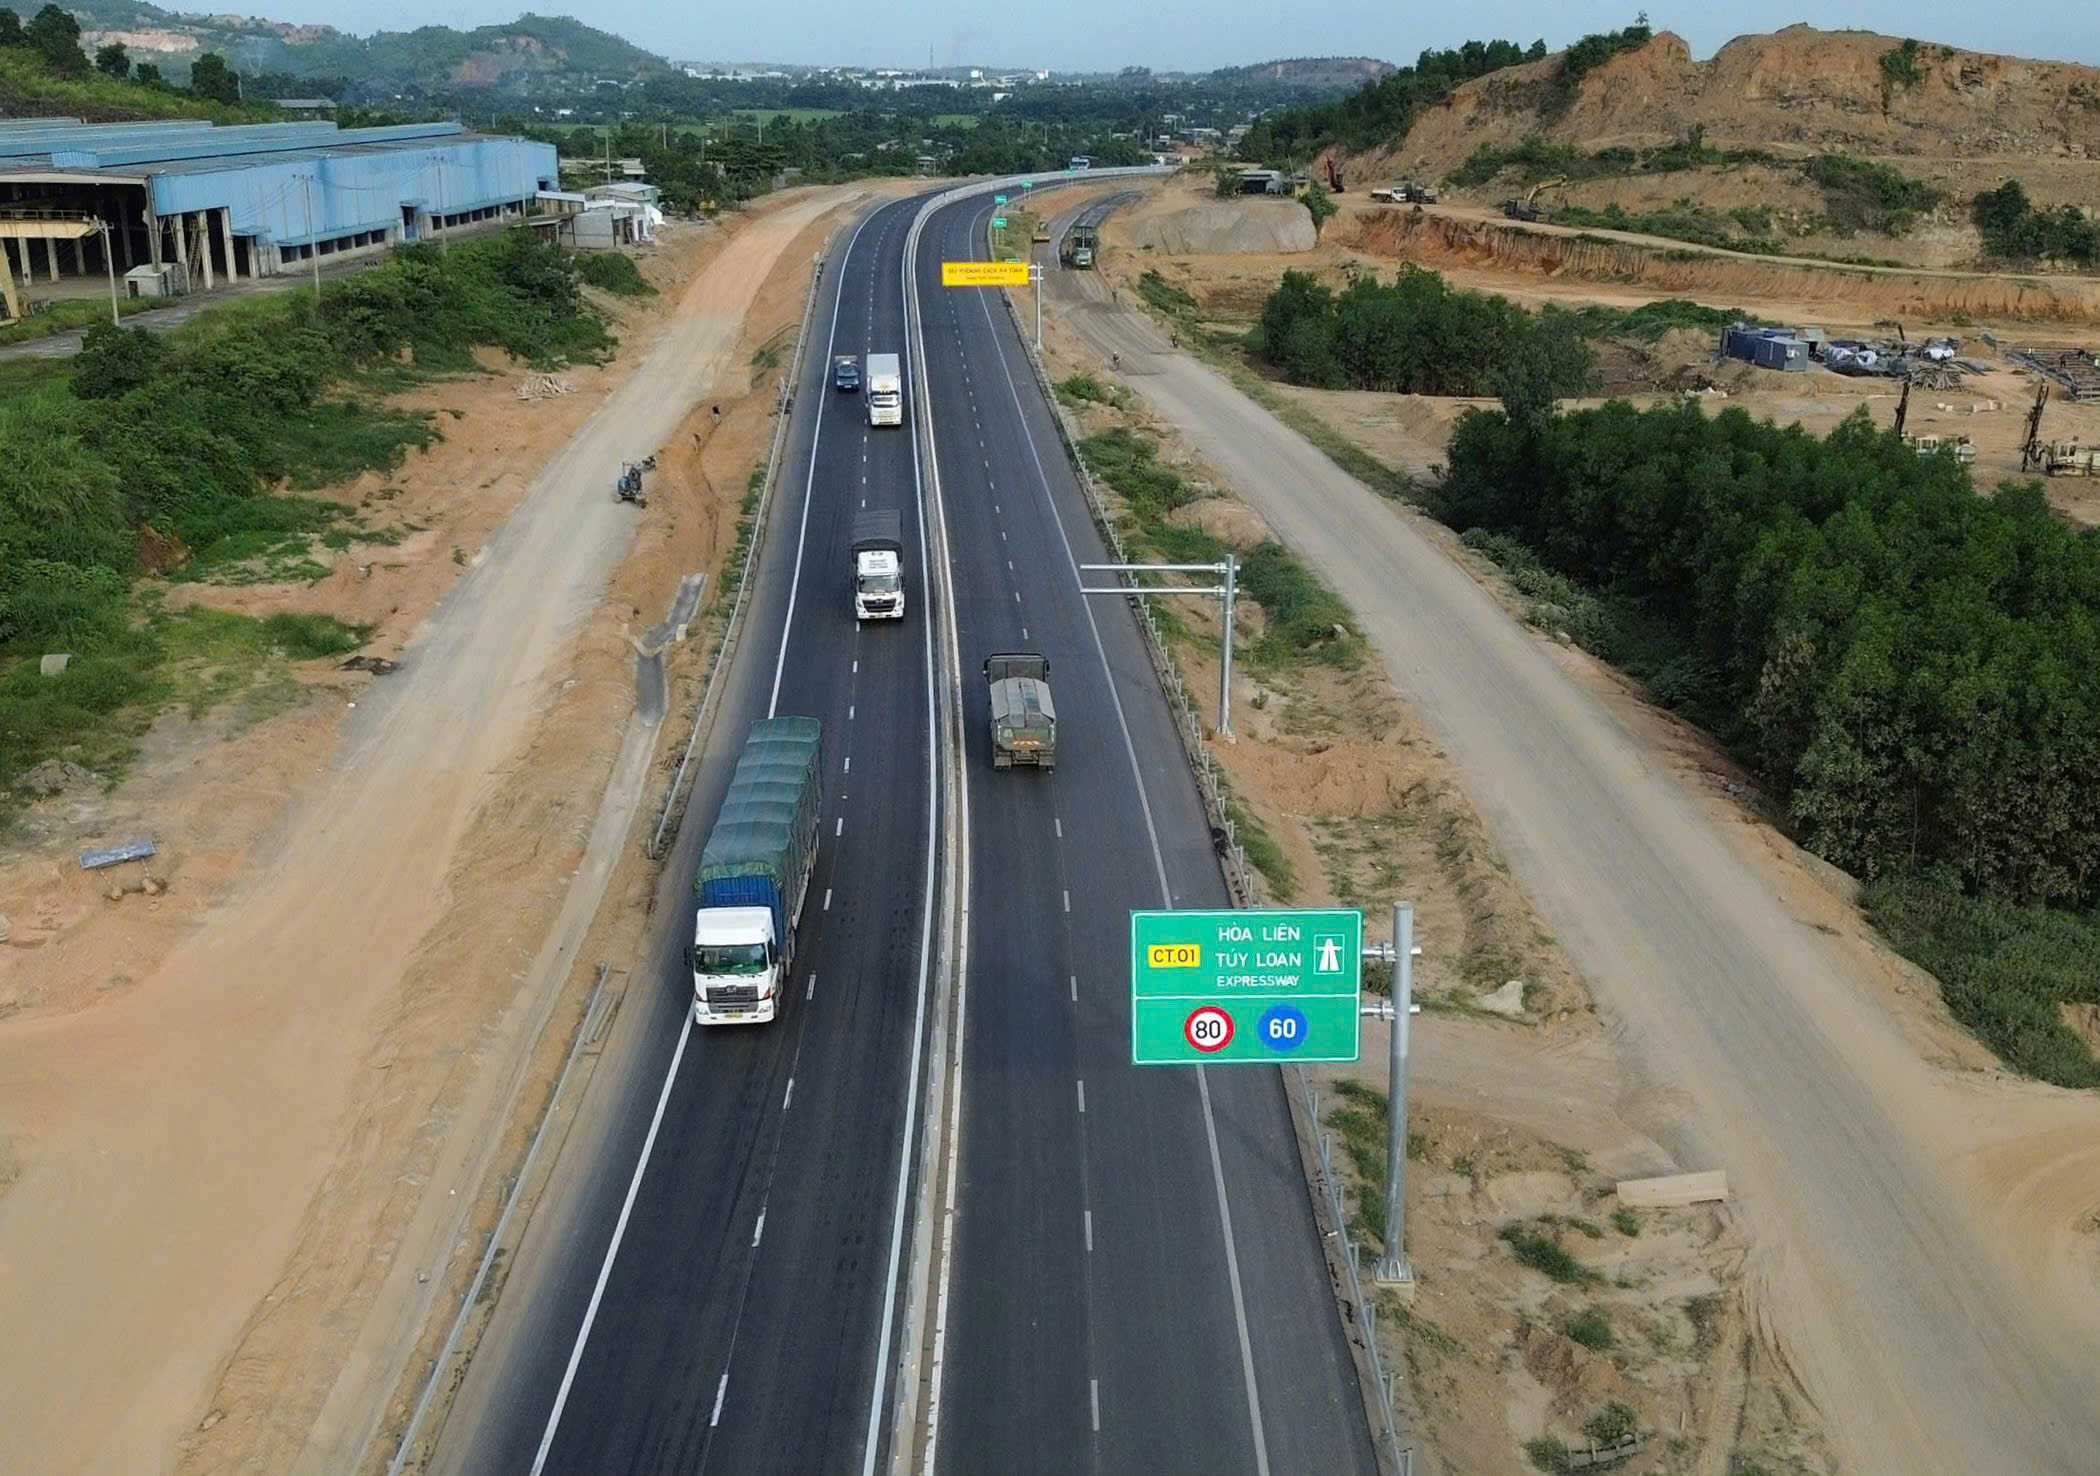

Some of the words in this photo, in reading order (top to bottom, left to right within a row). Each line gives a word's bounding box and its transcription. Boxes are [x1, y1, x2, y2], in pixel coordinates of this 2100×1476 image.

[1218, 922, 1253, 941] HÒA
[1263, 923, 1300, 941] LIÊN
[1153, 949, 1195, 963] CT.01
[1215, 949, 1248, 968] TÚY
[1256, 953, 1302, 968] LOAN
[1217, 975, 1300, 987] EXPRESSWAY
[1195, 1020, 1221, 1039] 80
[1269, 1018, 1296, 1039] 60
